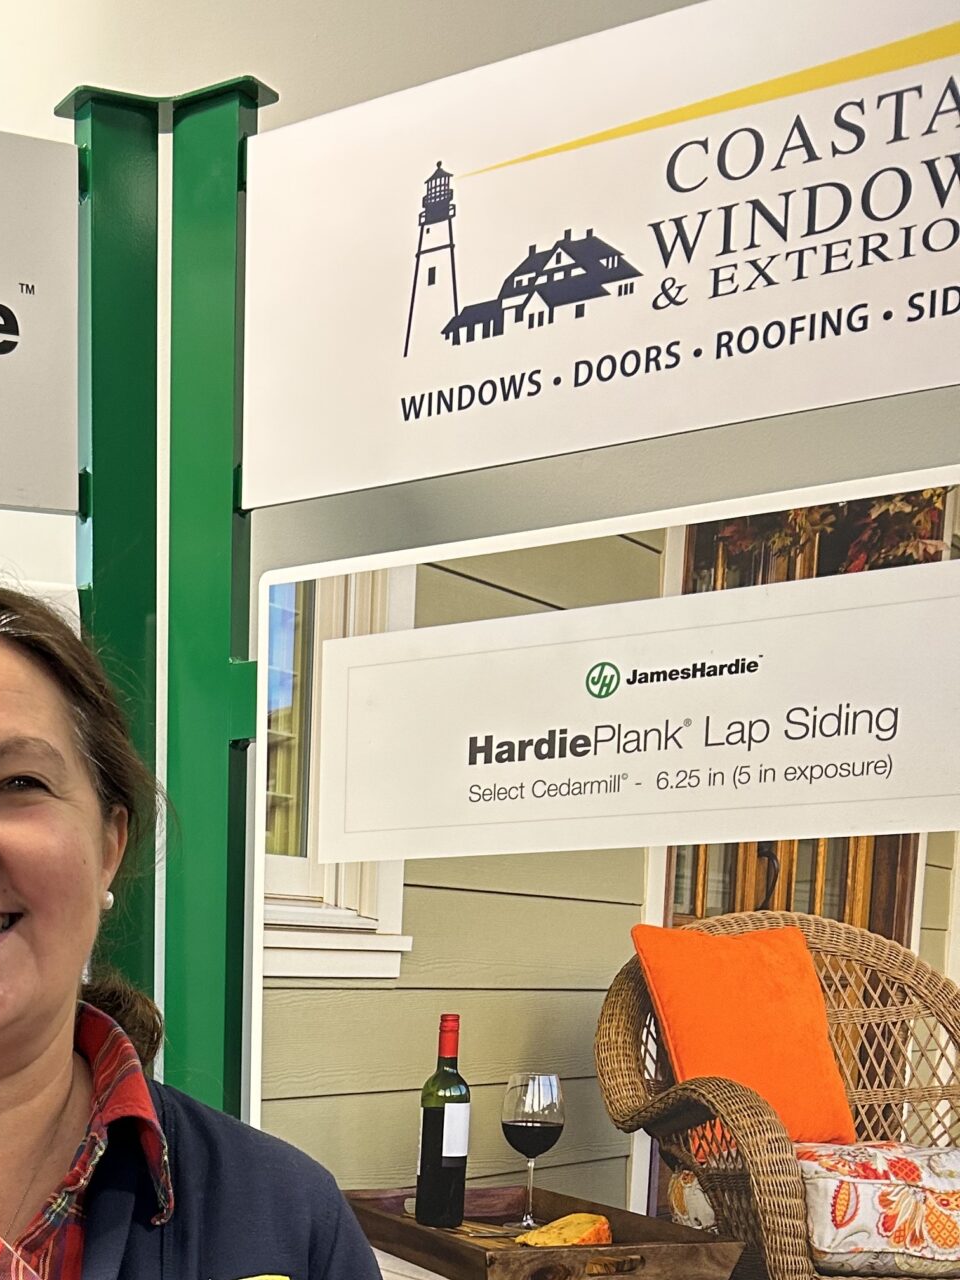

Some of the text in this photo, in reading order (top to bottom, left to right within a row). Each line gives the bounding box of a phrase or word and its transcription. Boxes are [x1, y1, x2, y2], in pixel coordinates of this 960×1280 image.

[651, 277, 689, 313] &
[401, 369, 542, 422] WINDOWS
[573, 340, 682, 389] DOORS
[716, 302, 869, 360] ROOFING
[704, 714, 770, 749] Lap
[784, 702, 900, 742] Siding
[468, 780, 525, 803] Select
[656, 769, 702, 791] 6.25
[708, 767, 725, 787] in
[732, 764, 752, 790] (5
[758, 762, 776, 783] in
[783, 754, 894, 786] exposure)
